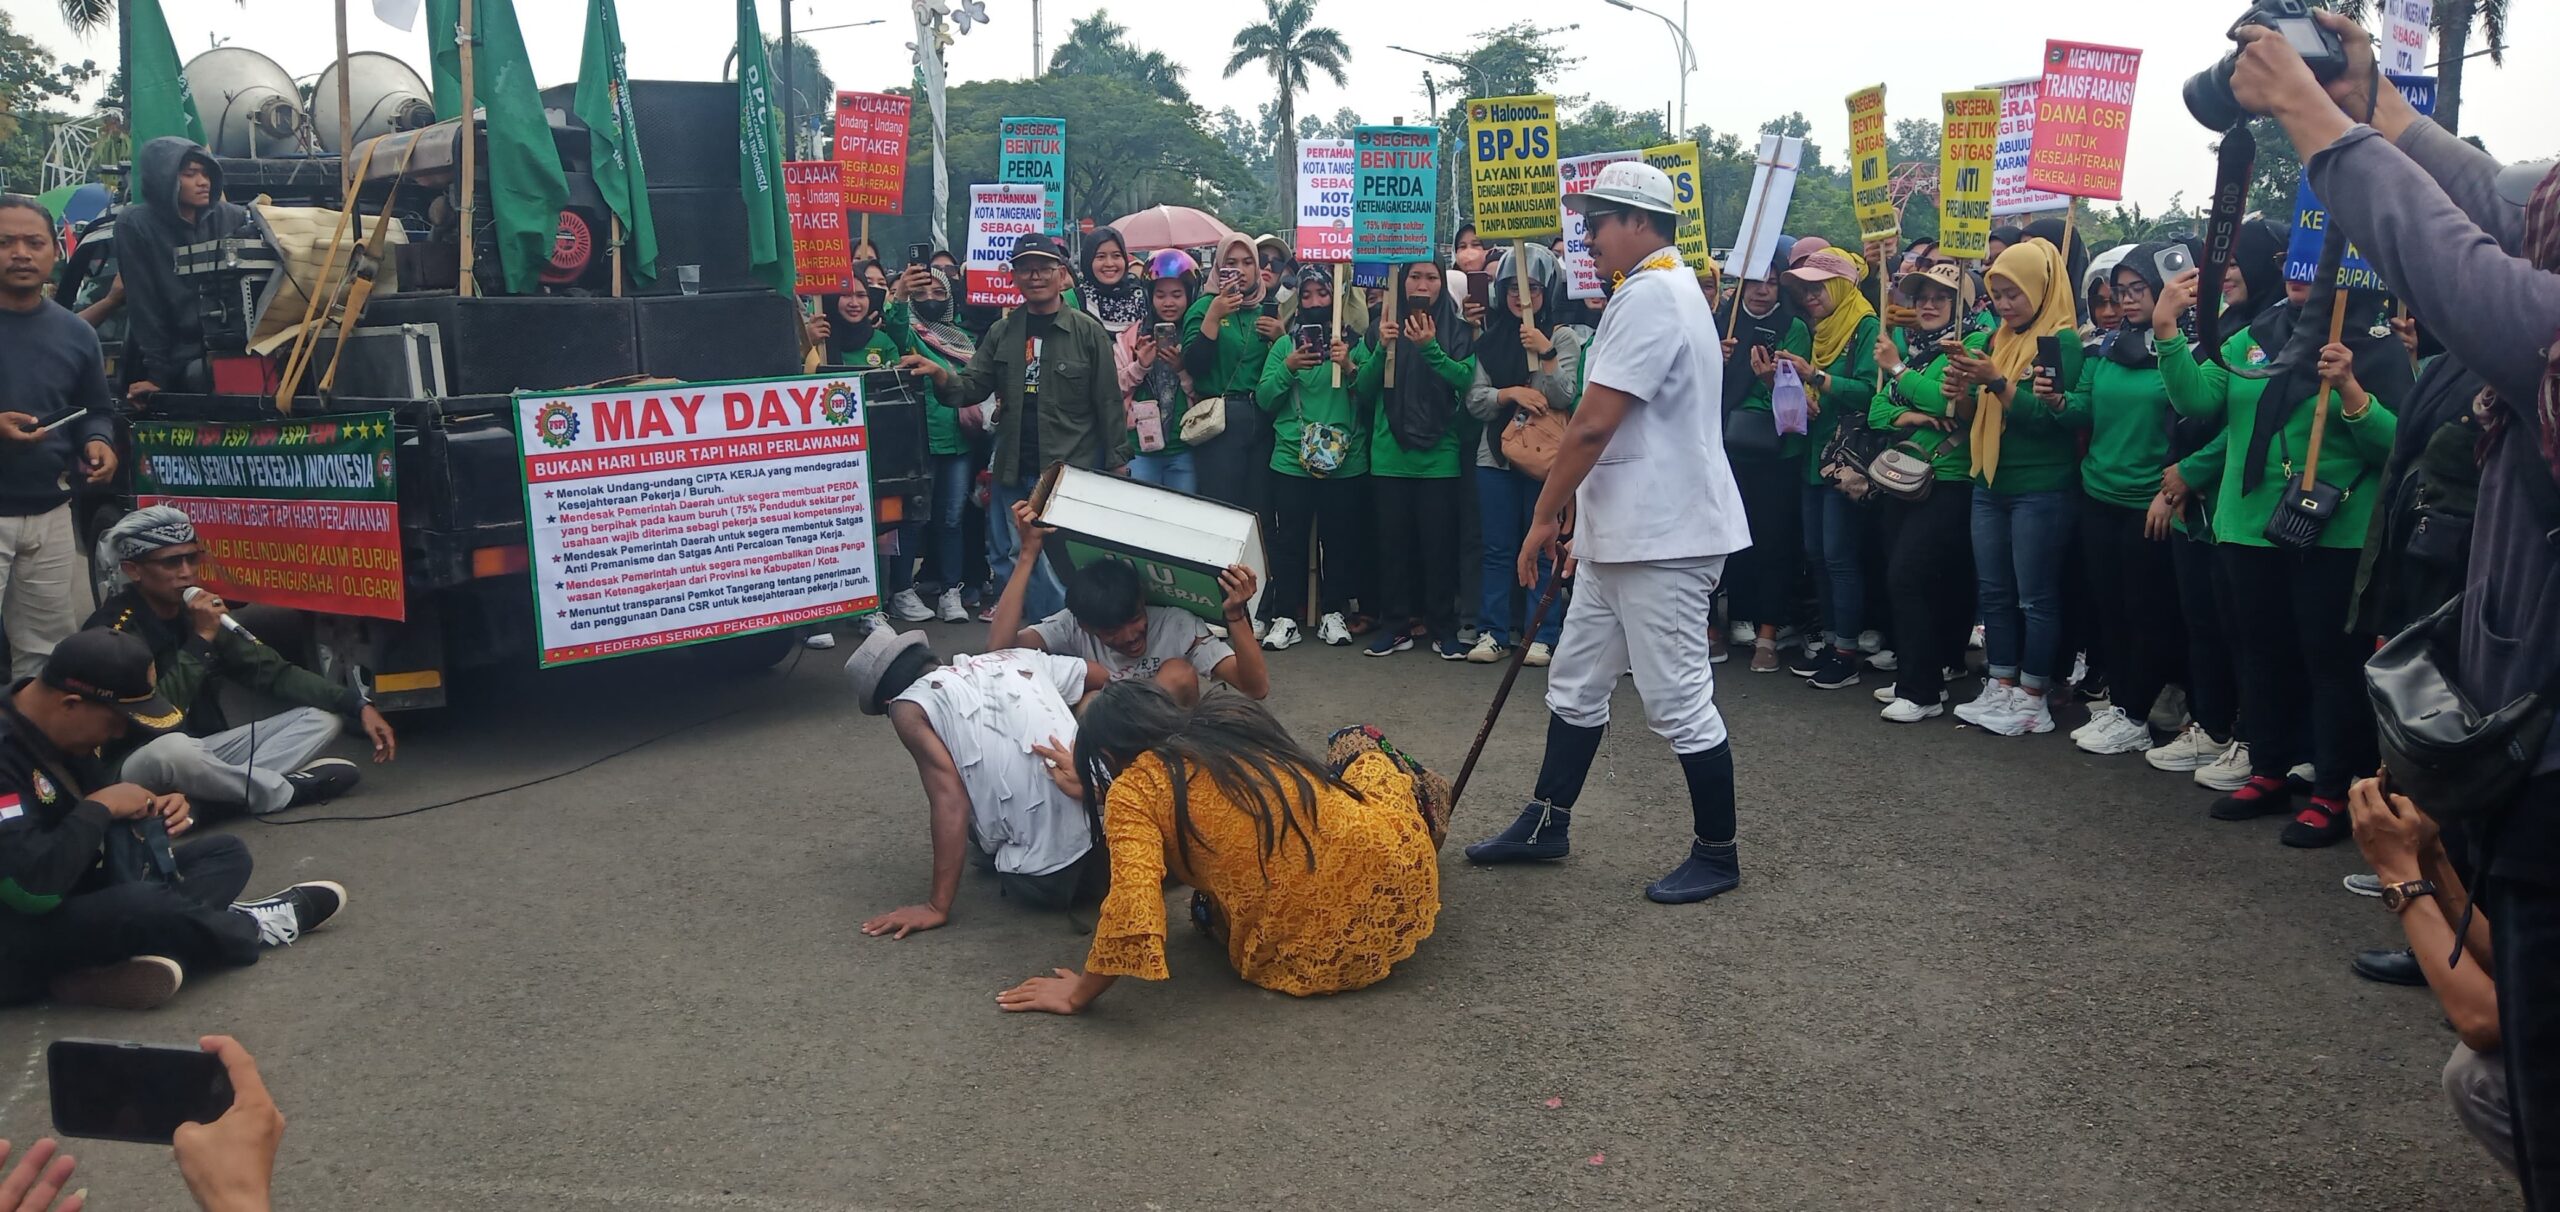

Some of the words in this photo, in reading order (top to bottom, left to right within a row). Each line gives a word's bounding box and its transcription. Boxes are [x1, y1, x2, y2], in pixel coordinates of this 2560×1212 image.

[2068, 48, 2138, 75] MENUNTUT
[2045, 74, 2135, 106] TRANSFARANSI
[855, 96, 905, 116] TOLAAAK
[1956, 98, 1995, 116] SEGERA
[2040, 103, 2087, 124] DANA
[2092, 108, 2126, 130] CSR
[840, 115, 868, 133] Undang
[875, 117, 903, 137] Undang
[1014, 124, 1058, 136] SEGERA
[1948, 121, 1996, 139] BENTUK
[841, 136, 899, 156] CIPTAKER
[1005, 140, 1060, 155] BENTUK
[1373, 134, 1430, 146] SEGERA
[1477, 126, 1550, 162] BPJS
[1856, 133, 1885, 154] SATGAS
[2056, 133, 2098, 150] UNTUK
[1360, 152, 1432, 168] BENTUK
[1950, 144, 1993, 161] SATGAS
[2034, 149, 2122, 172] KESEJAHTERAAN
[1007, 160, 1053, 178] PERDA
[1303, 162, 1326, 174] KOTA
[1476, 167, 1520, 182] LAYANI
[1524, 165, 1555, 179] KAMI
[1862, 157, 1878, 182] ANTI
[2033, 168, 2076, 187] PEKERJA
[2083, 173, 2117, 190] BURUH
[1363, 176, 1423, 196] PERDA
[1478, 185, 1505, 198] DENGAN
[1532, 181, 1555, 194] MUDAH
[1956, 168, 1979, 192] ANTI
[977, 193, 1037, 204] PERTAHANKAN
[1356, 201, 1431, 213] KETENAGAKERJAAN
[1479, 202, 1499, 215] DAN
[1502, 198, 1556, 213] MANUSIAWI
[2220, 182, 2240, 214] 60D
[975, 207, 995, 219] KOTA
[996, 207, 1041, 220] TANGERANG
[1946, 200, 1989, 220] PREMANISME
[980, 222, 1035, 233] SEBAGAI
[1481, 219, 1506, 232] TANPA
[1508, 215, 1556, 230] DISKRIMINASI
[2211, 221, 2233, 265] EOS
[2290, 261, 2318, 282] DAN
[592, 395, 703, 441] MAY
[723, 387, 818, 430] DAY
[171, 428, 194, 446] FSPI
[222, 426, 249, 446] FSPI
[535, 458, 592, 476] BUKAN
[597, 454, 635, 469] HARI
[640, 449, 685, 465] LIBUR
[690, 446, 723, 460] TAPI
[728, 442, 762, 457] HARI
[767, 434, 858, 452] PERLAWANAN
[152, 455, 202, 485] FEDERASI
[201, 454, 245, 486] SERIKAT
[249, 454, 302, 487] PEKERJA
[304, 453, 375, 487] INDONESIA
[556, 485, 603, 498] Menolak
[607, 477, 692, 492] Undang-undang
[695, 472, 727, 483] CIPTA
[730, 468, 765, 479] KERJA
[767, 467, 791, 477] yang
[794, 459, 859, 472] mendegradasi
[558, 495, 637, 510] Kesejahteraan
[640, 489, 680, 501] Pekerja
[689, 484, 723, 496] Buruh.
[559, 509, 614, 523] Mendesak
[617, 502, 676, 516] Pemerintah
[679, 498, 714, 509] Daerah
[717, 493, 745, 504] untuk
[747, 491, 779, 502] segera
[782, 485, 825, 497] membuat
[827, 481, 858, 492] PERDA
[190, 501, 219, 524] BUKAN
[222, 503, 241, 525] HARI
[270, 505, 291, 528] TAPI
[293, 505, 318, 528] HARI
[319, 506, 390, 533] PERLAWANAN
[560, 526, 588, 537] yang
[591, 518, 637, 532] berpihak
[640, 515, 665, 528] pada
[668, 513, 695, 522] kaum
[698, 507, 727, 519] buruh
[736, 504, 757, 514] 75%
[759, 498, 806, 511] Penduduk
[809, 495, 839, 505] sekitar
[841, 494, 855, 503] per
[562, 534, 608, 548] usahaan
[611, 530, 639, 542] wajib
[642, 526, 683, 538] diterima
[721, 516, 757, 529] pekerja
[760, 511, 791, 523] sesuai
[563, 547, 617, 561] Mendesak
[620, 539, 677, 554] Pemerintah
[680, 534, 715, 546] Daerah
[718, 530, 745, 541] untuk
[747, 527, 779, 538] segera
[781, 519, 833, 532] membentuk
[835, 516, 863, 526] Satgas
[233, 540, 308, 565] MELINDUNGI
[310, 544, 348, 567] KAUM
[352, 547, 399, 572] BURUH
[564, 563, 587, 574] Anti
[590, 556, 654, 570] Premanisme
[657, 552, 675, 561] dan
[678, 548, 711, 558] Satgas
[714, 543, 734, 553] Anti
[736, 538, 783, 550] Percaloan
[785, 534, 817, 543] Tenaga
[820, 529, 844, 539] Kerja.
[566, 576, 618, 590] Mendesak
[621, 567, 677, 582] Pemerintah
[679, 563, 706, 574] untuk
[709, 559, 740, 570] segera
[743, 549, 813, 564] mengembalikan
[815, 545, 839, 554] Dinas
[841, 541, 865, 551] Penga
[263, 568, 333, 594] PENGUSAHA
[569, 603, 620, 617] Menuntut
[622, 592, 684, 610] transparansi
[687, 587, 724, 599] Pemkot
[726, 580, 775, 593] Tangerang
[777, 575, 811, 586] tentang
[813, 567, 860, 582] penerimaan
[570, 620, 590, 630] dan
[593, 607, 657, 628] penggunaan
[660, 606, 685, 616] Dana
[688, 600, 709, 611] CSR
[712, 596, 739, 608] untuk
[741, 587, 805, 603] kesejahteraan
[807, 581, 838, 594] pekerja
[844, 576, 869, 586] buruh.
[595, 634, 662, 653] FEDERASI
[666, 625, 719, 641] SERIKAT
[723, 615, 779, 631] PEKERJA
[782, 604, 843, 622] INDONESIA
